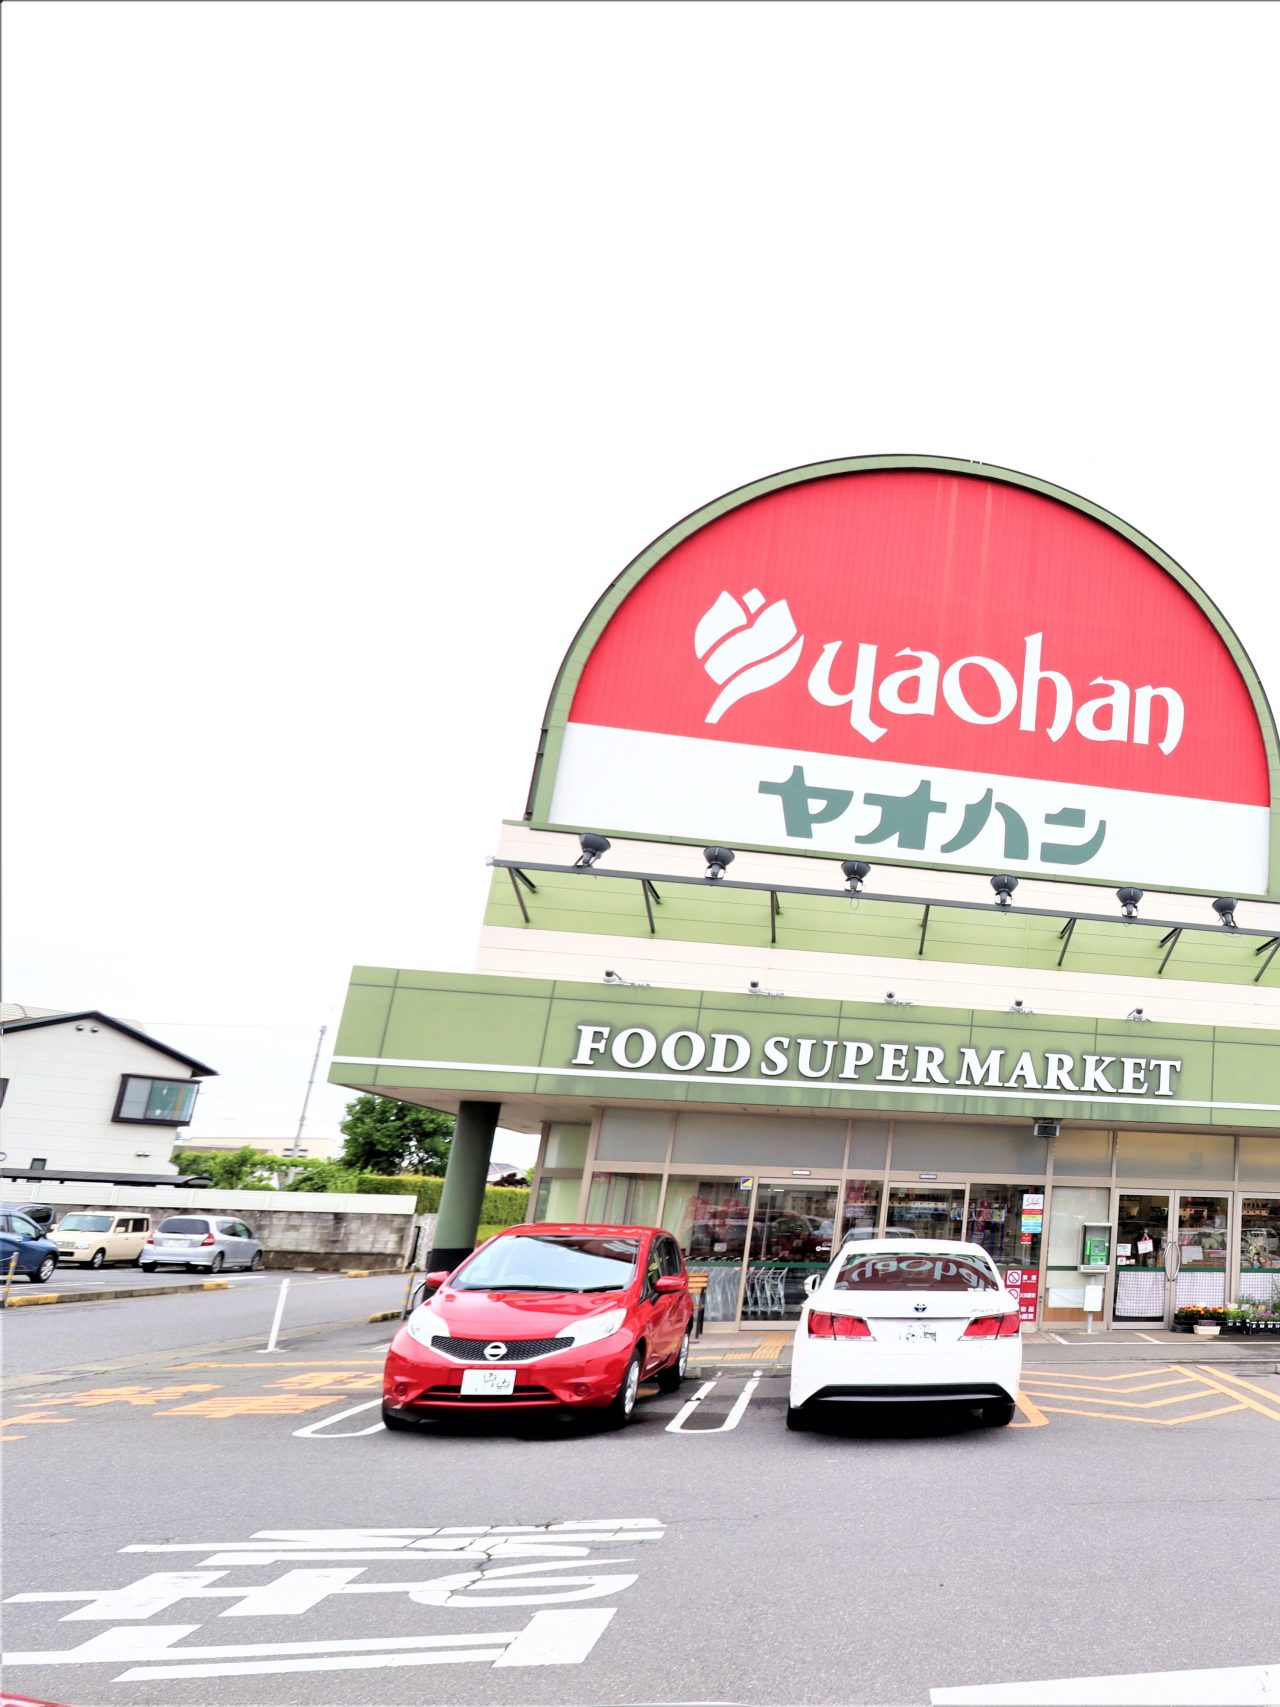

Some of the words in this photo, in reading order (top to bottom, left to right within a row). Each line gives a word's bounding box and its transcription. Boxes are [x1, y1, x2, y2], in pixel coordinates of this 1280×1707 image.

[808, 632, 1185, 756] yaohan
[758, 764, 1107, 865] ヤオハン
[571, 1024, 752, 1074] FOOD
[760, 1035, 948, 1085] SUPER
[957, 1047, 1183, 1097] MARKET
